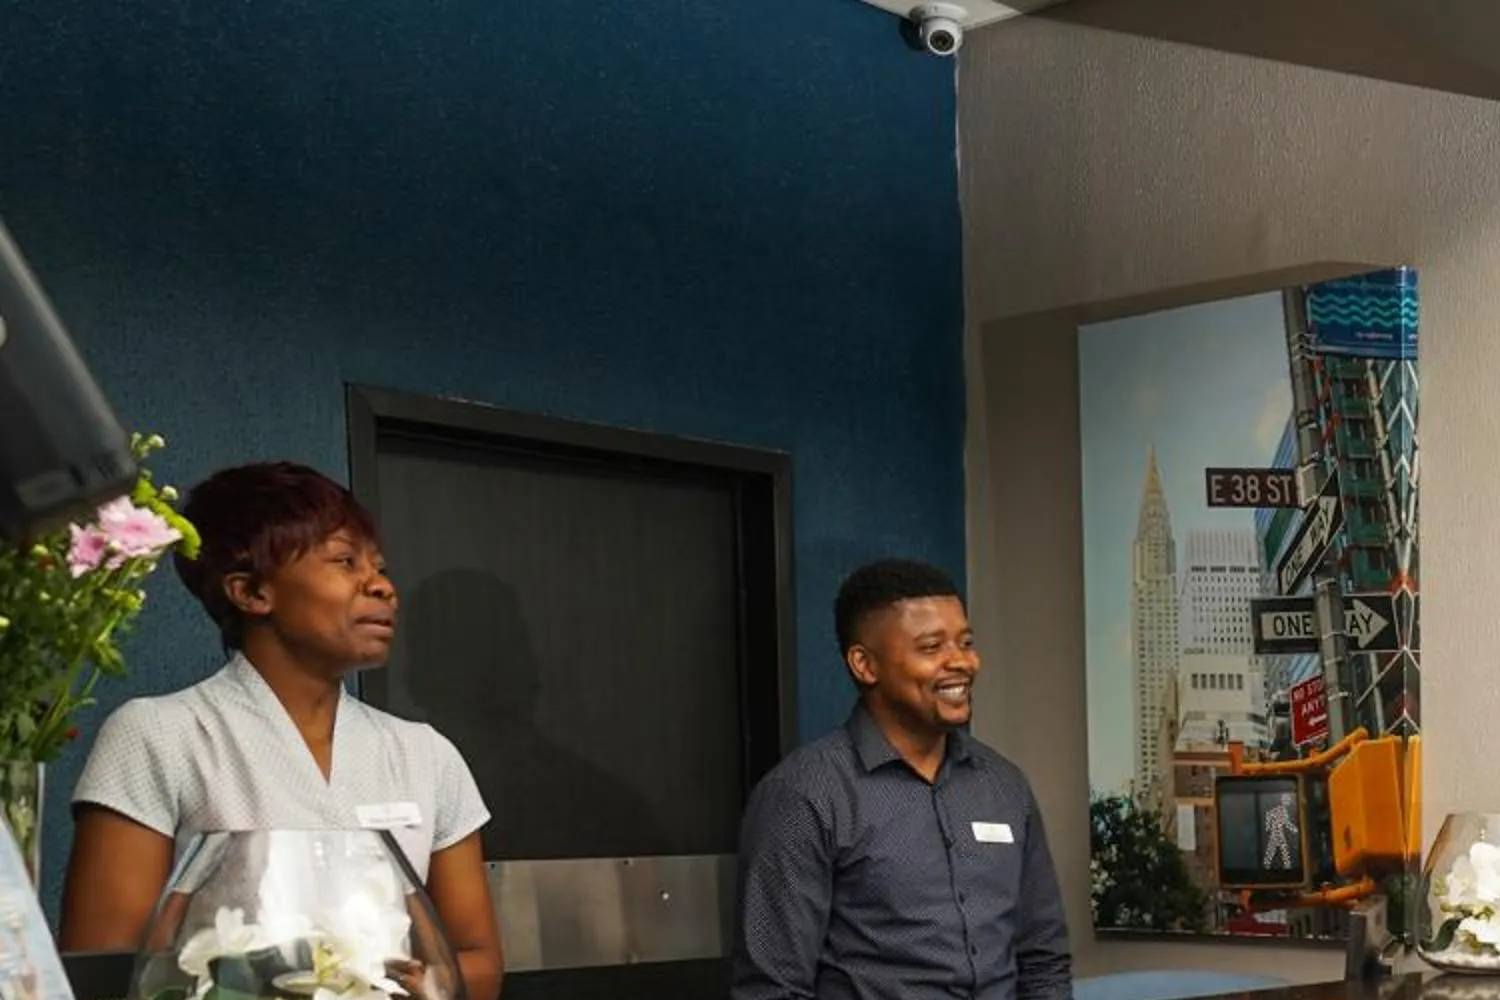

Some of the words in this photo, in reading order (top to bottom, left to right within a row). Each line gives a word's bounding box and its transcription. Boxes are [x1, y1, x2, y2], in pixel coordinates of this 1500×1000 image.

[1210, 475, 1224, 503] E
[1231, 474, 1260, 503] 38
[1267, 475, 1293, 504] ST
[1273, 614, 1315, 636] ONE
[1350, 612, 1373, 637] AY
